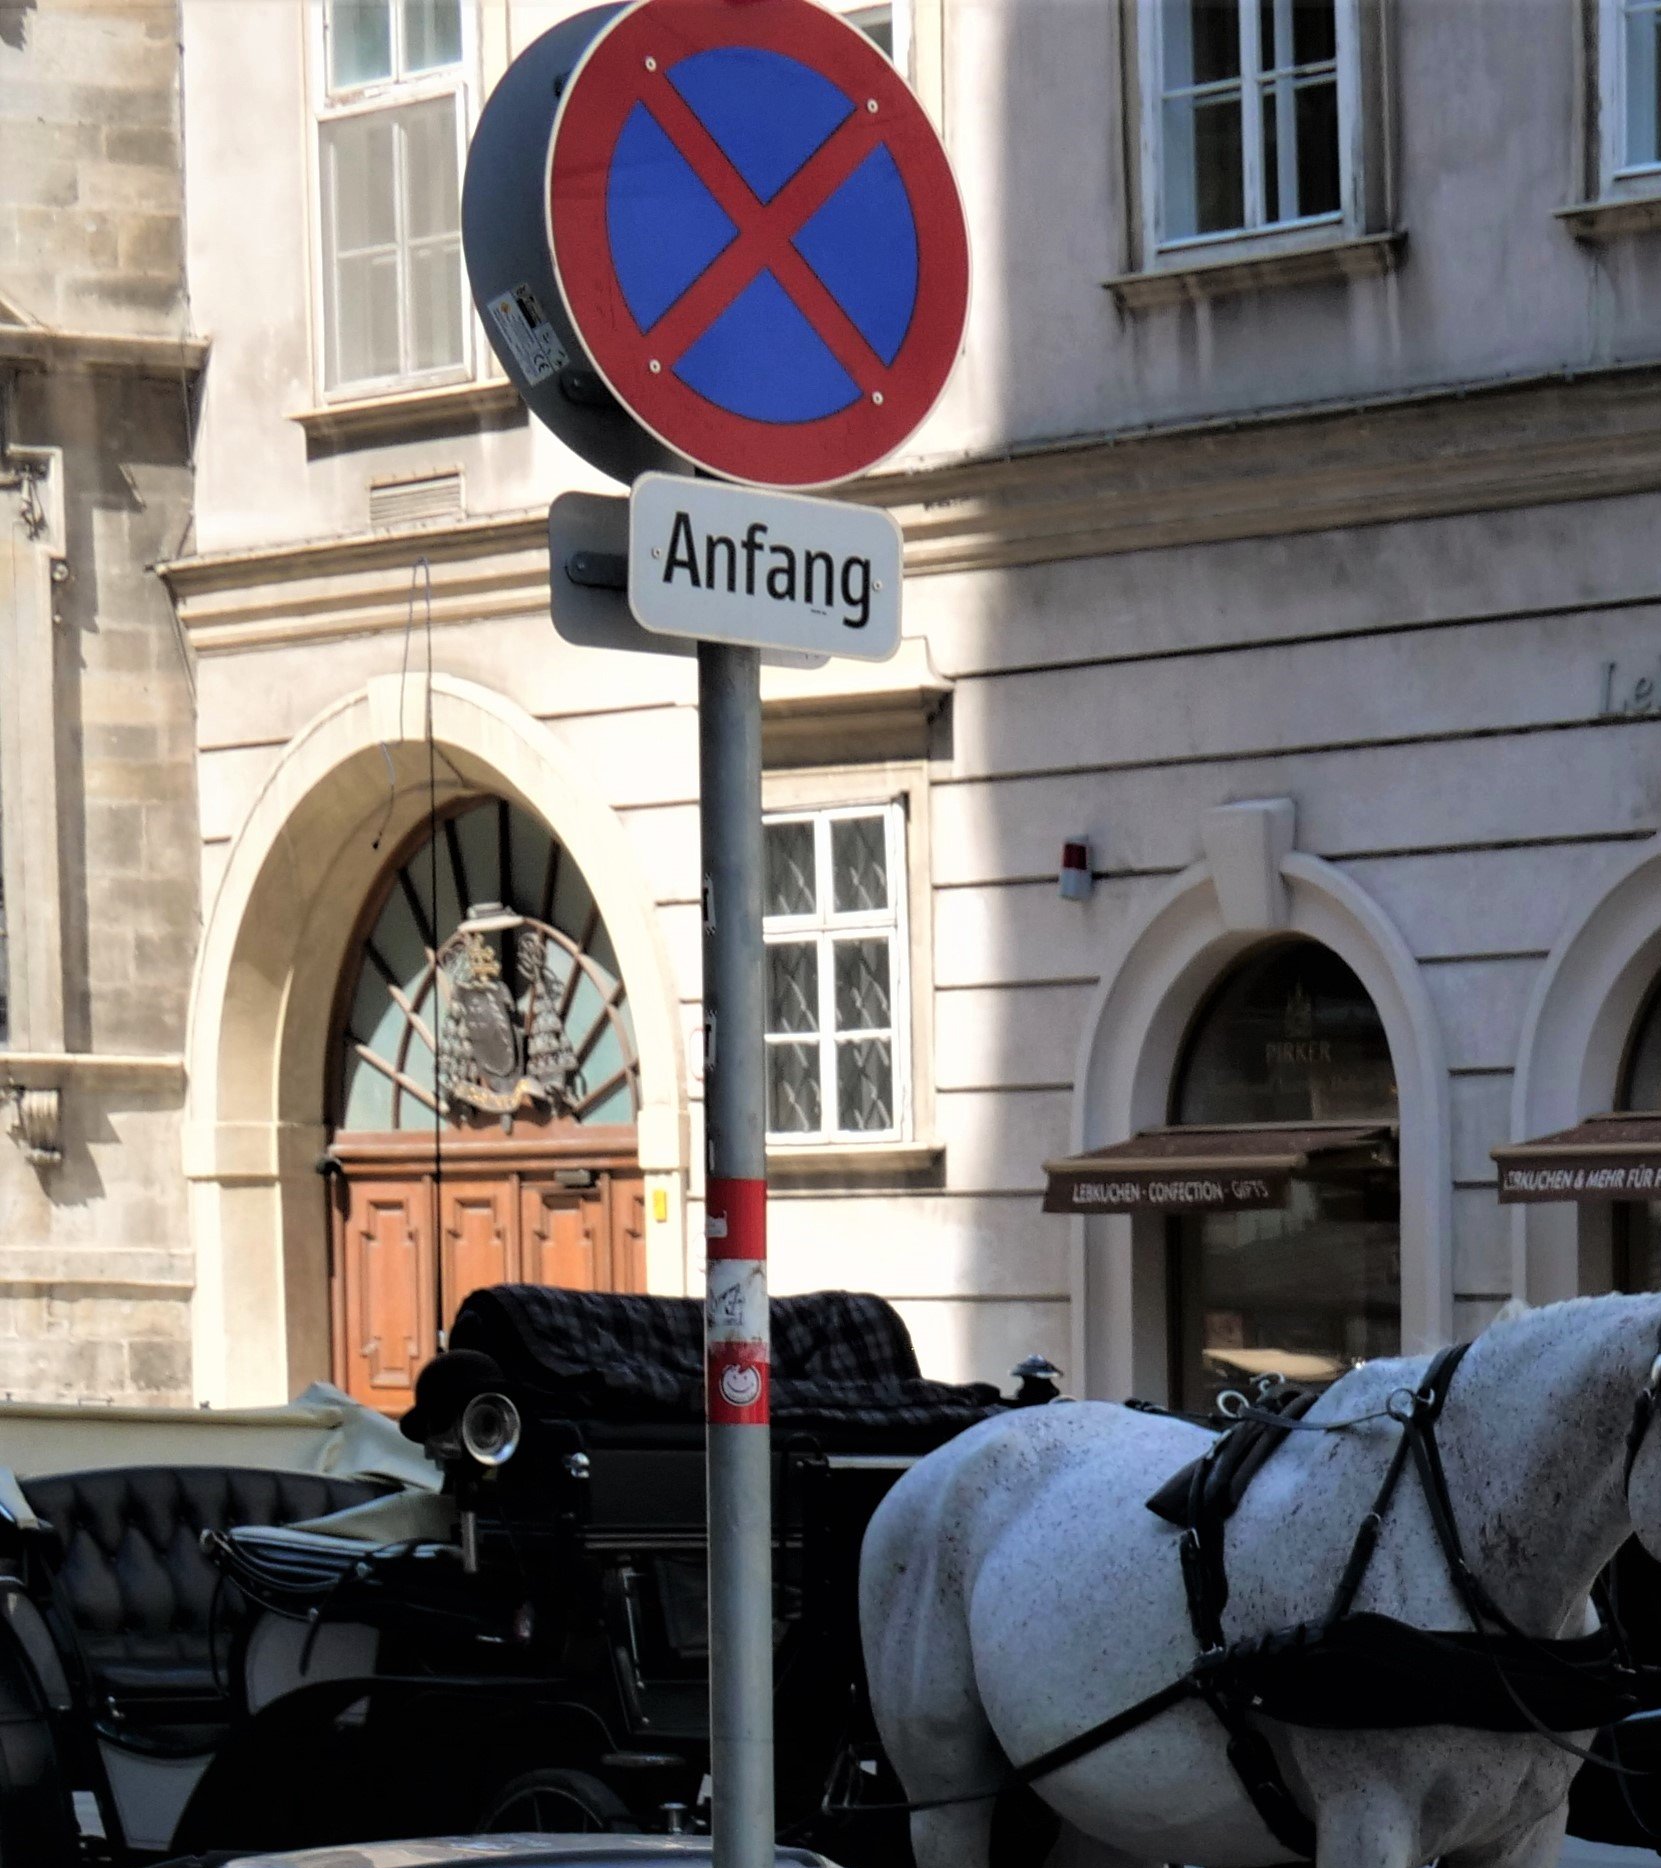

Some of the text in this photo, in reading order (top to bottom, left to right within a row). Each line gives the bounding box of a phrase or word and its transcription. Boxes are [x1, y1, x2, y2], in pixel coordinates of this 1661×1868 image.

[663, 511, 870, 629] Anfang
[1265, 1041, 1332, 1064] PIRKER
[1573, 1167, 1585, 1190] &
[1585, 1167, 1624, 1189] MEHR
[1626, 1163, 1654, 1188] FÜR
[1072, 1179, 1270, 1204] LEBKUCHEN CONFECTION GIFTS
